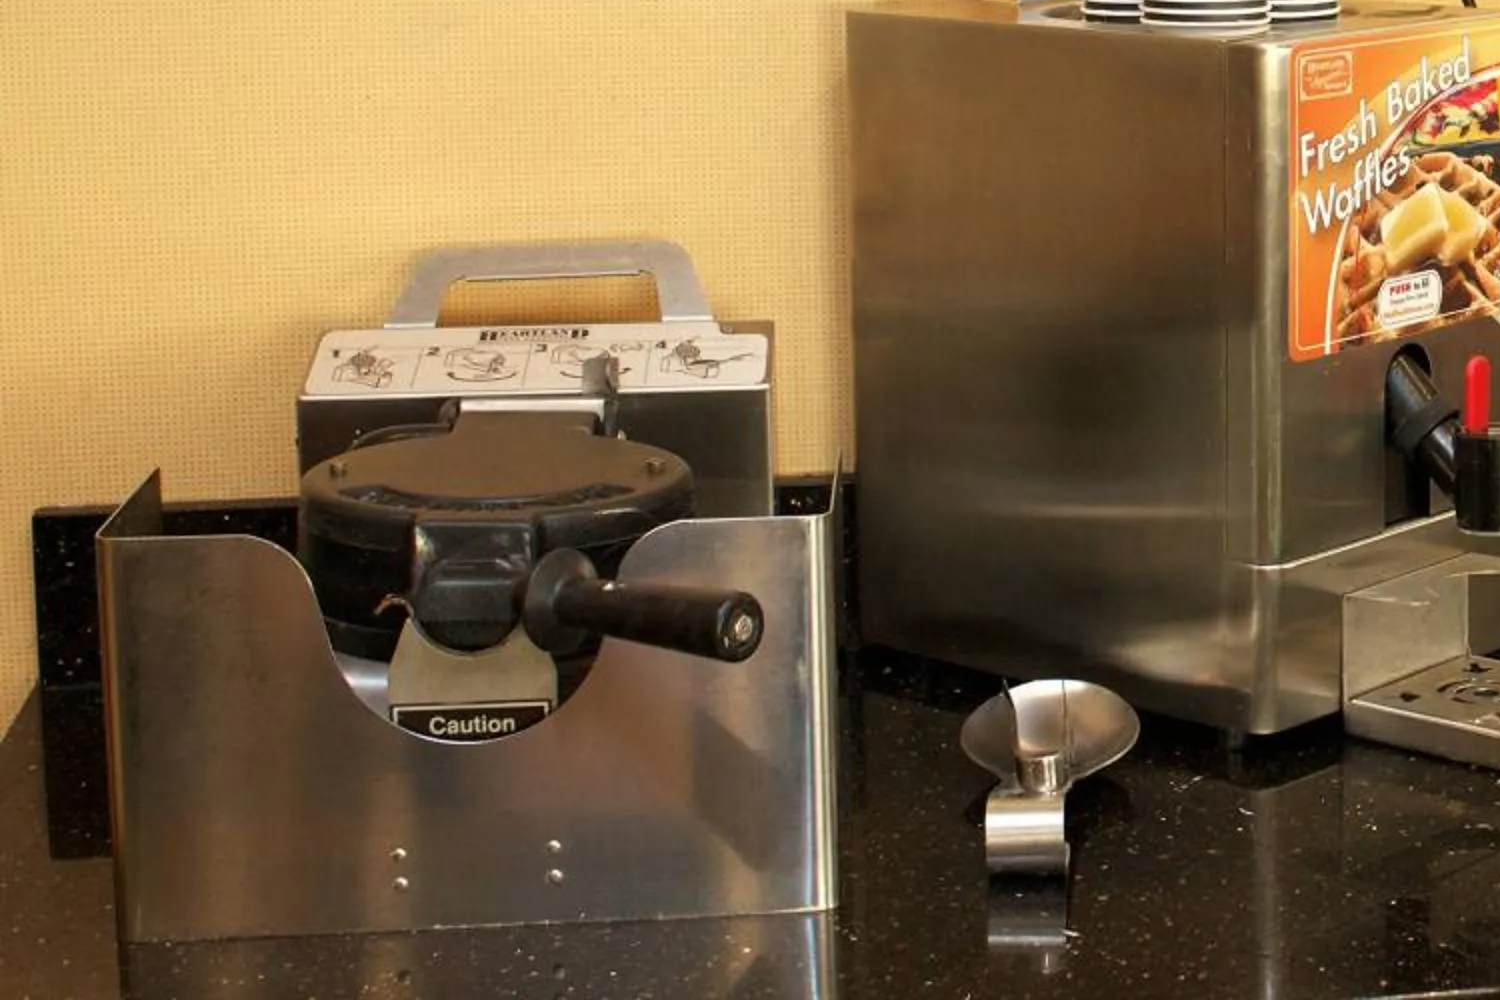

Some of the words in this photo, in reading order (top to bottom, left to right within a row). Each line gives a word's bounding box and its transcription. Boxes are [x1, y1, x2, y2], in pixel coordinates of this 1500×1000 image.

[1300, 98, 1377, 177] Fresh
[1387, 34, 1471, 121] Baked
[1302, 145, 1413, 233] Waffles
[429, 715, 515, 735] Caution
